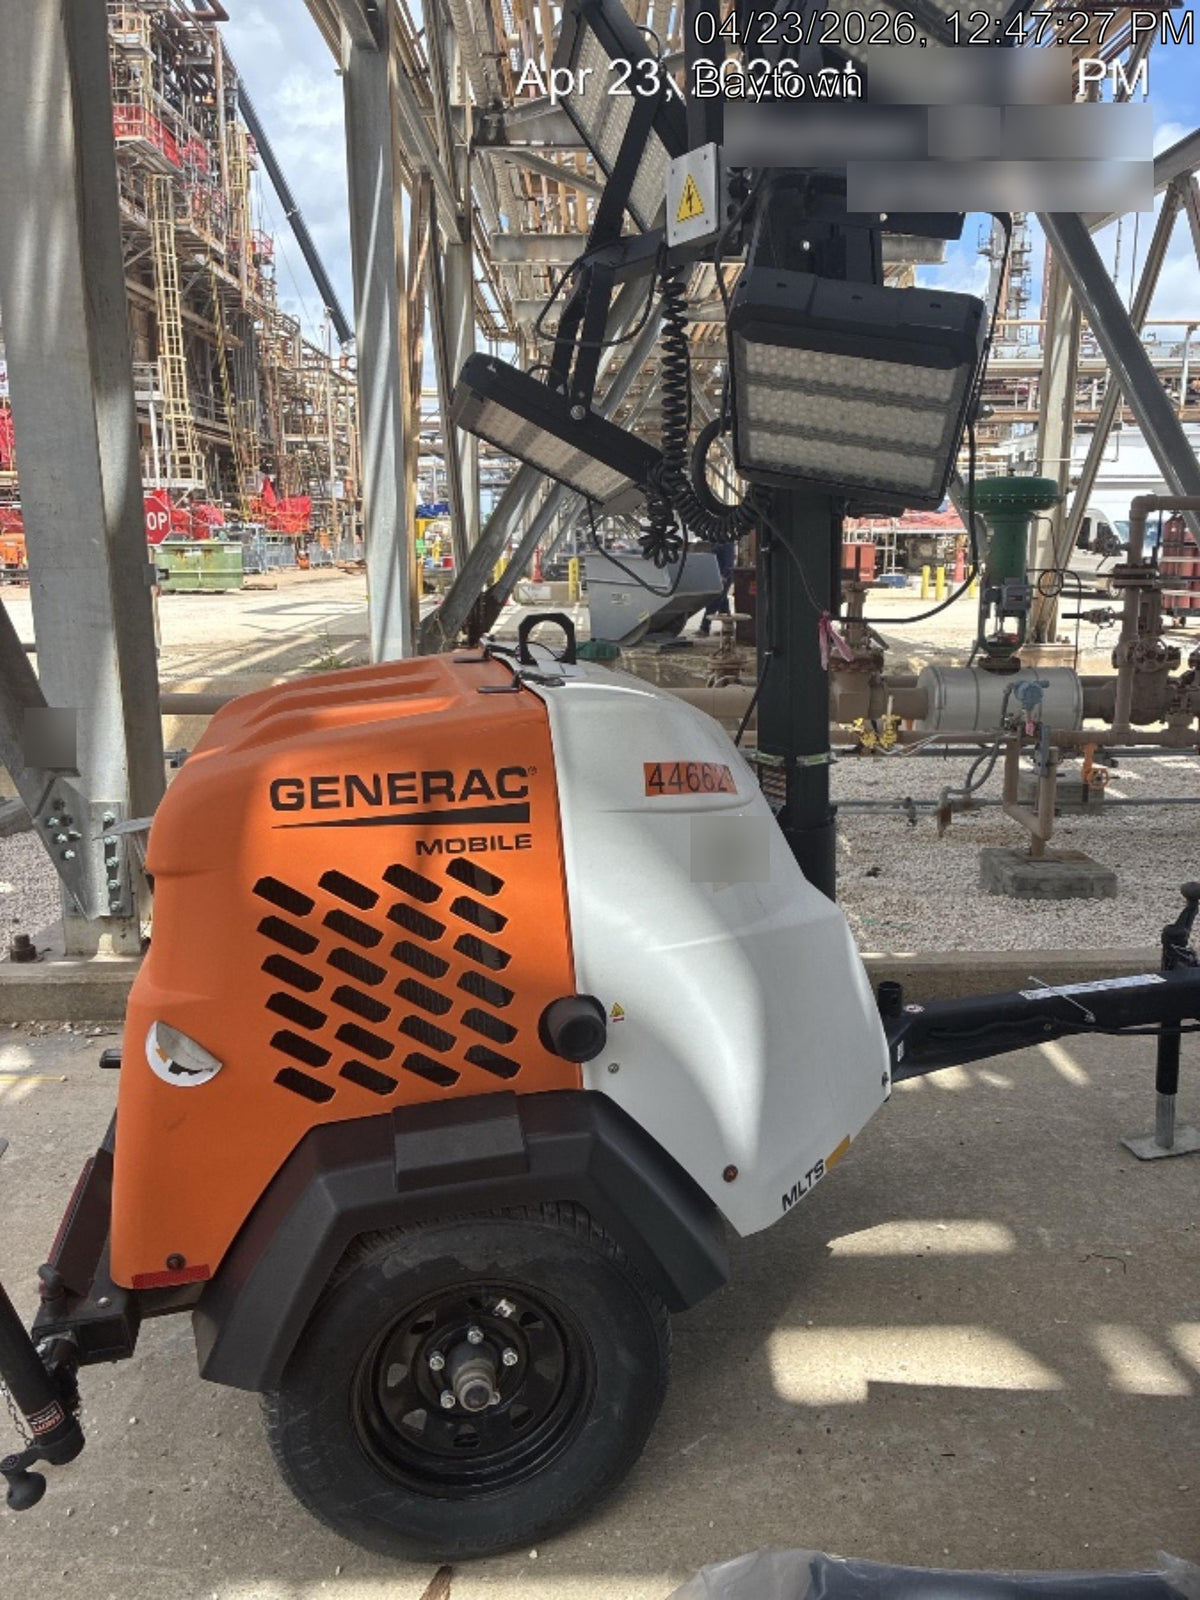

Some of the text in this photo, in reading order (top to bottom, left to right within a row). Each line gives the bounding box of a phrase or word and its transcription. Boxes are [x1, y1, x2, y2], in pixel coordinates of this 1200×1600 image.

[146, 511, 168, 531] OP
[270, 766, 529, 811] GENERAC
[415, 833, 532, 856] MOBILE
[781, 1158, 825, 1212] MLTS
